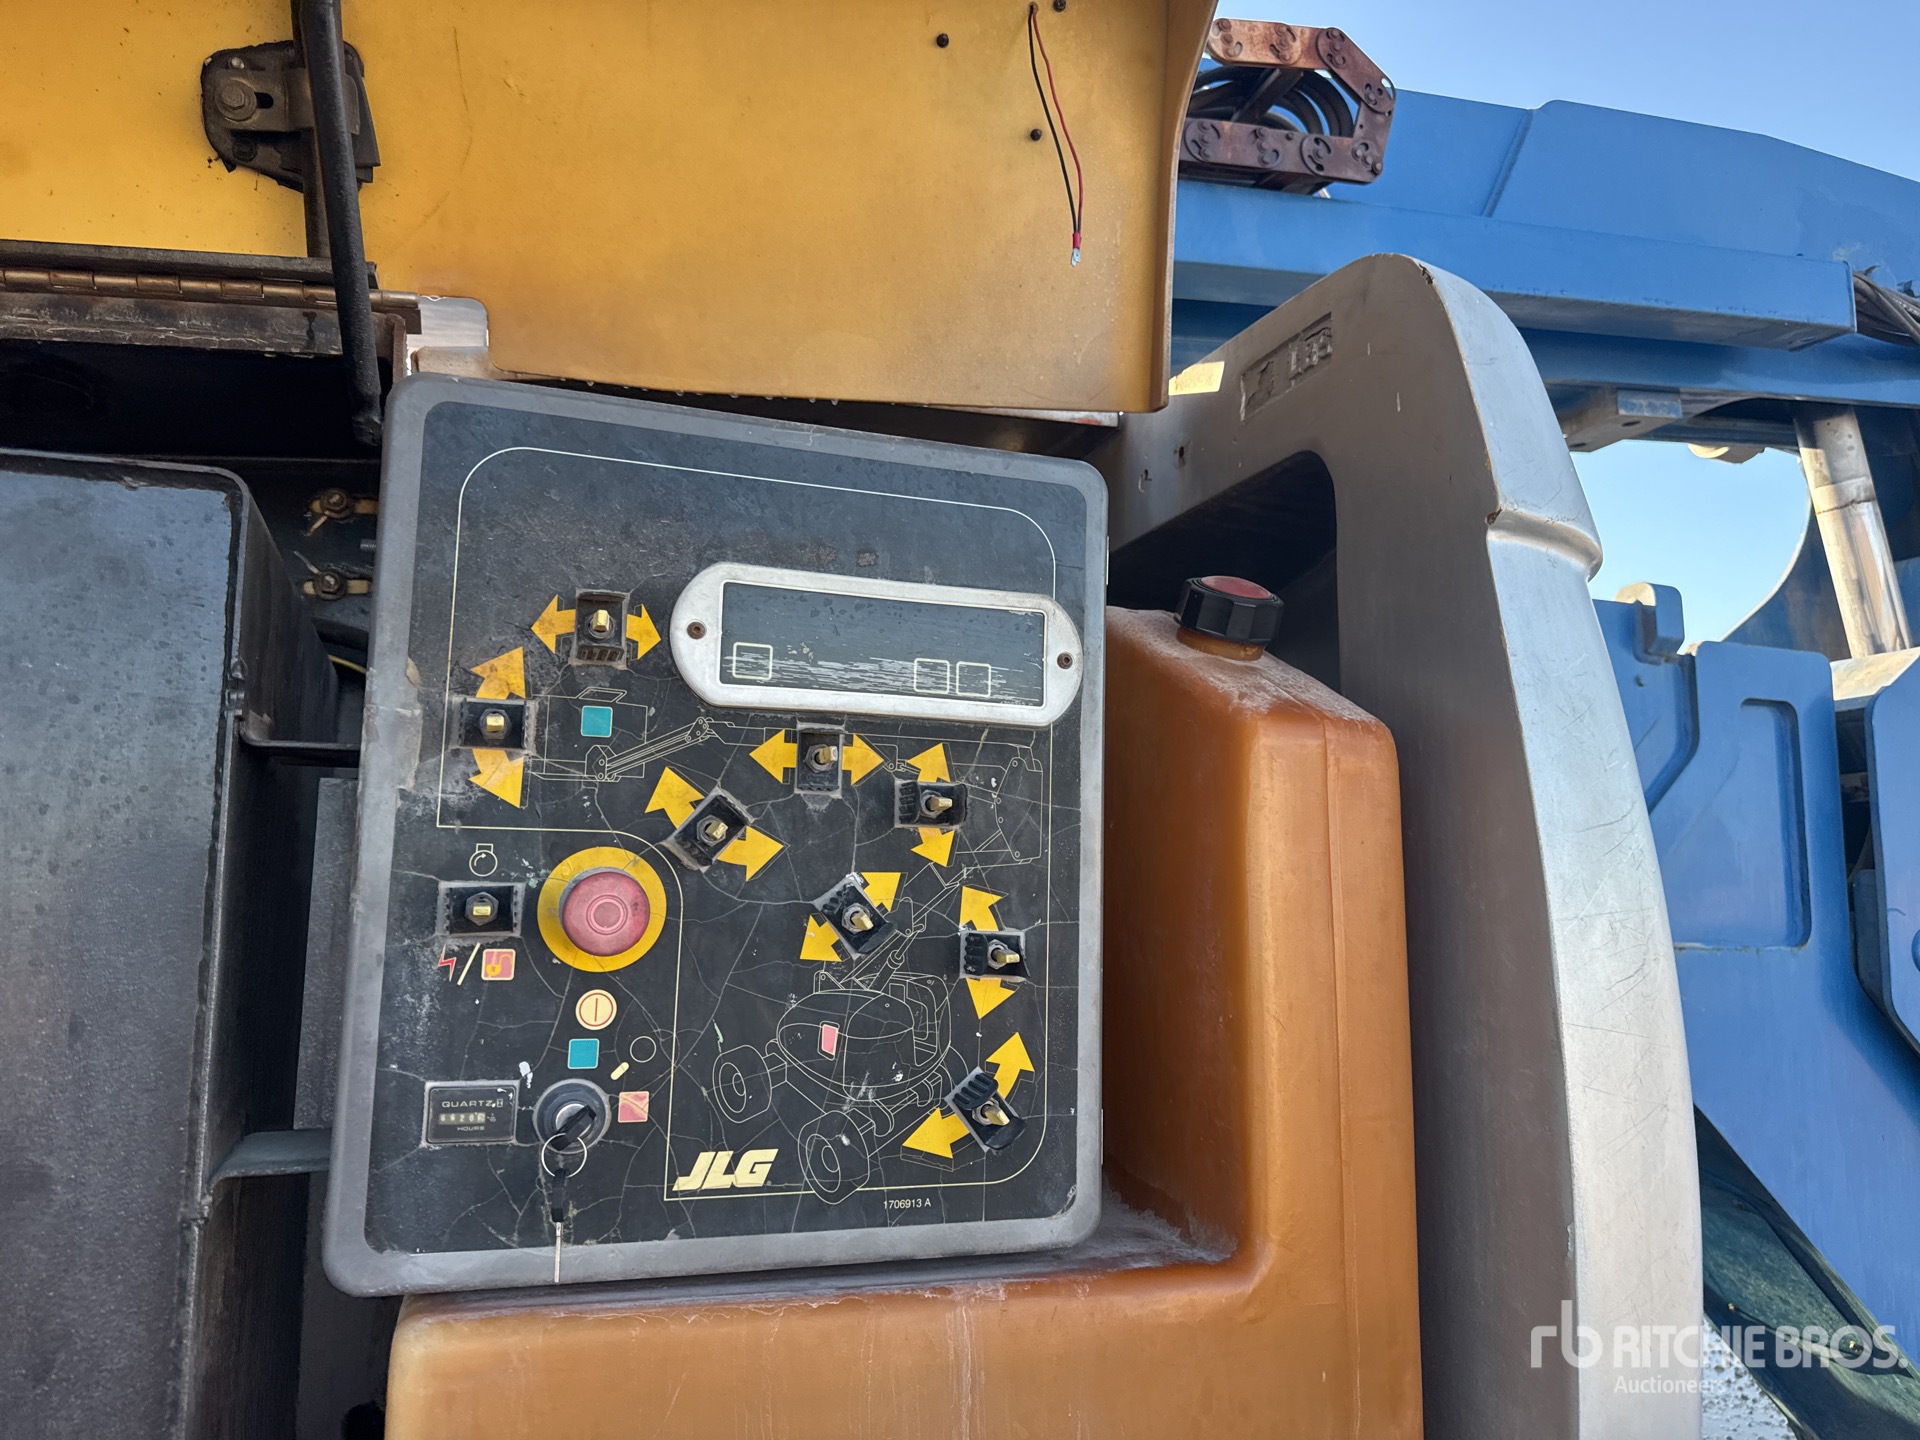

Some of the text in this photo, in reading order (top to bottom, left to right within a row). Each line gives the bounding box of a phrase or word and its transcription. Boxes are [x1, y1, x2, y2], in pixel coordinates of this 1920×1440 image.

[441, 1100, 493, 1108] QUARTZ
[672, 1149, 779, 1191] JLG
[883, 1198, 931, 1209] 1706913 A
